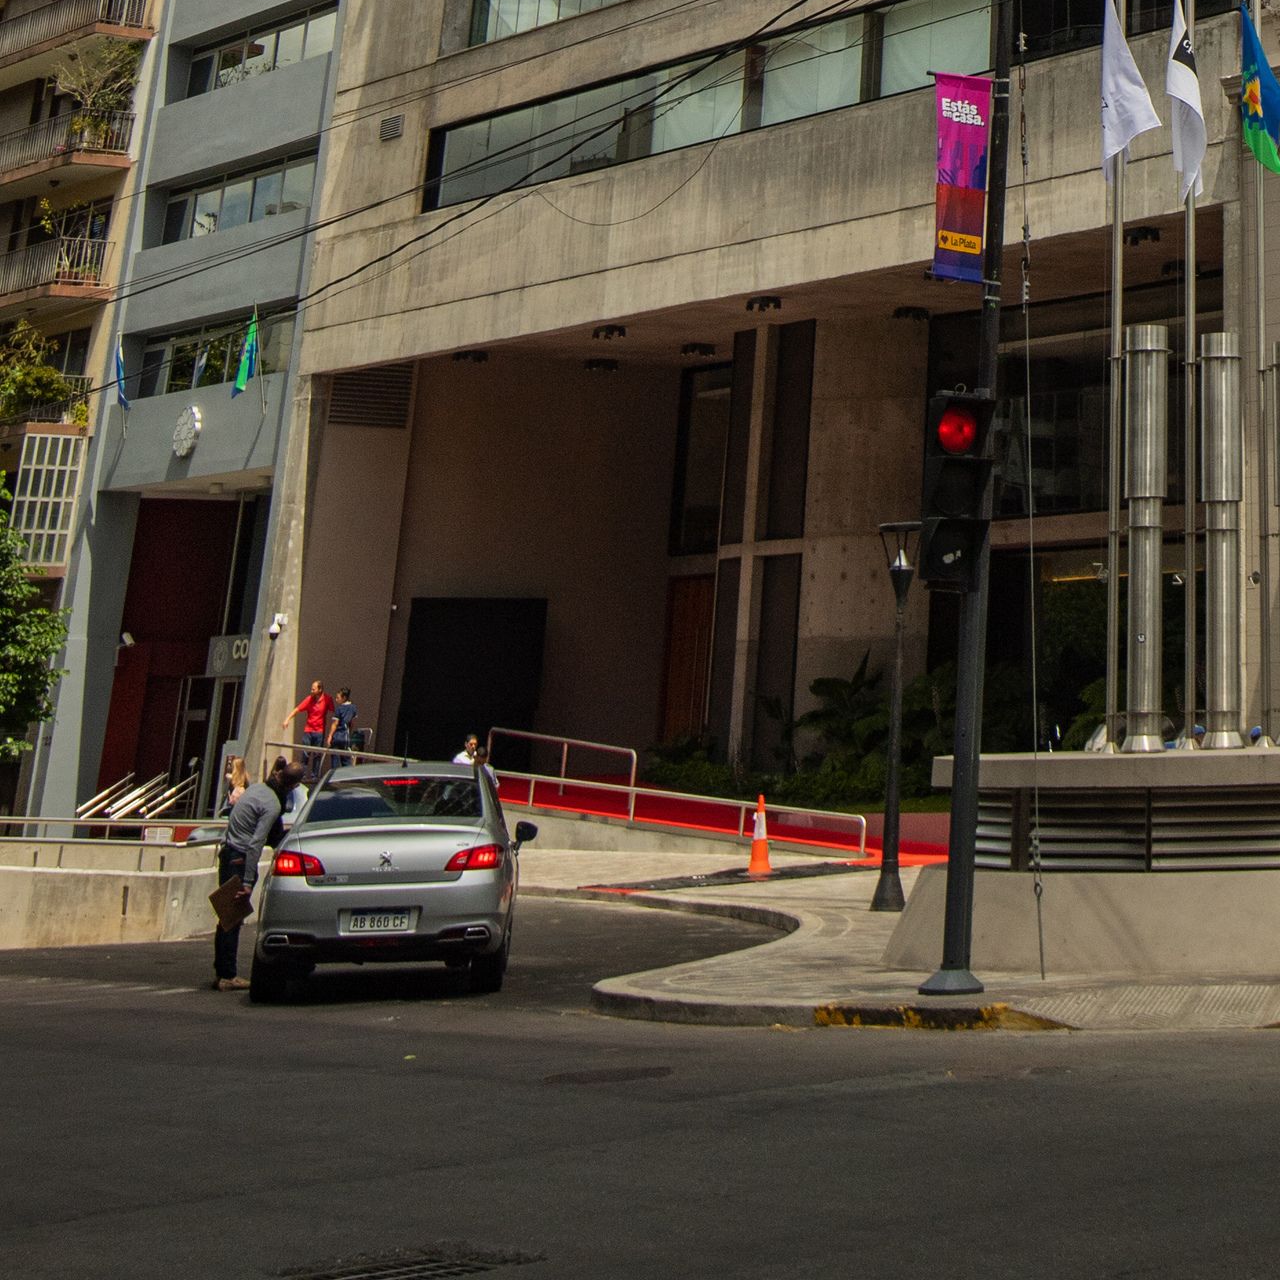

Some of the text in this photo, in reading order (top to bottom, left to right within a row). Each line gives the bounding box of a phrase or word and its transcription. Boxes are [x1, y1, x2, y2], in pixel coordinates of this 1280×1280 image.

[942, 97, 978, 115] Estás
[942, 110, 984, 126] en casa.
[951, 236, 976, 249] La Plata
[352, 915, 406, 929] AB 860 CF
